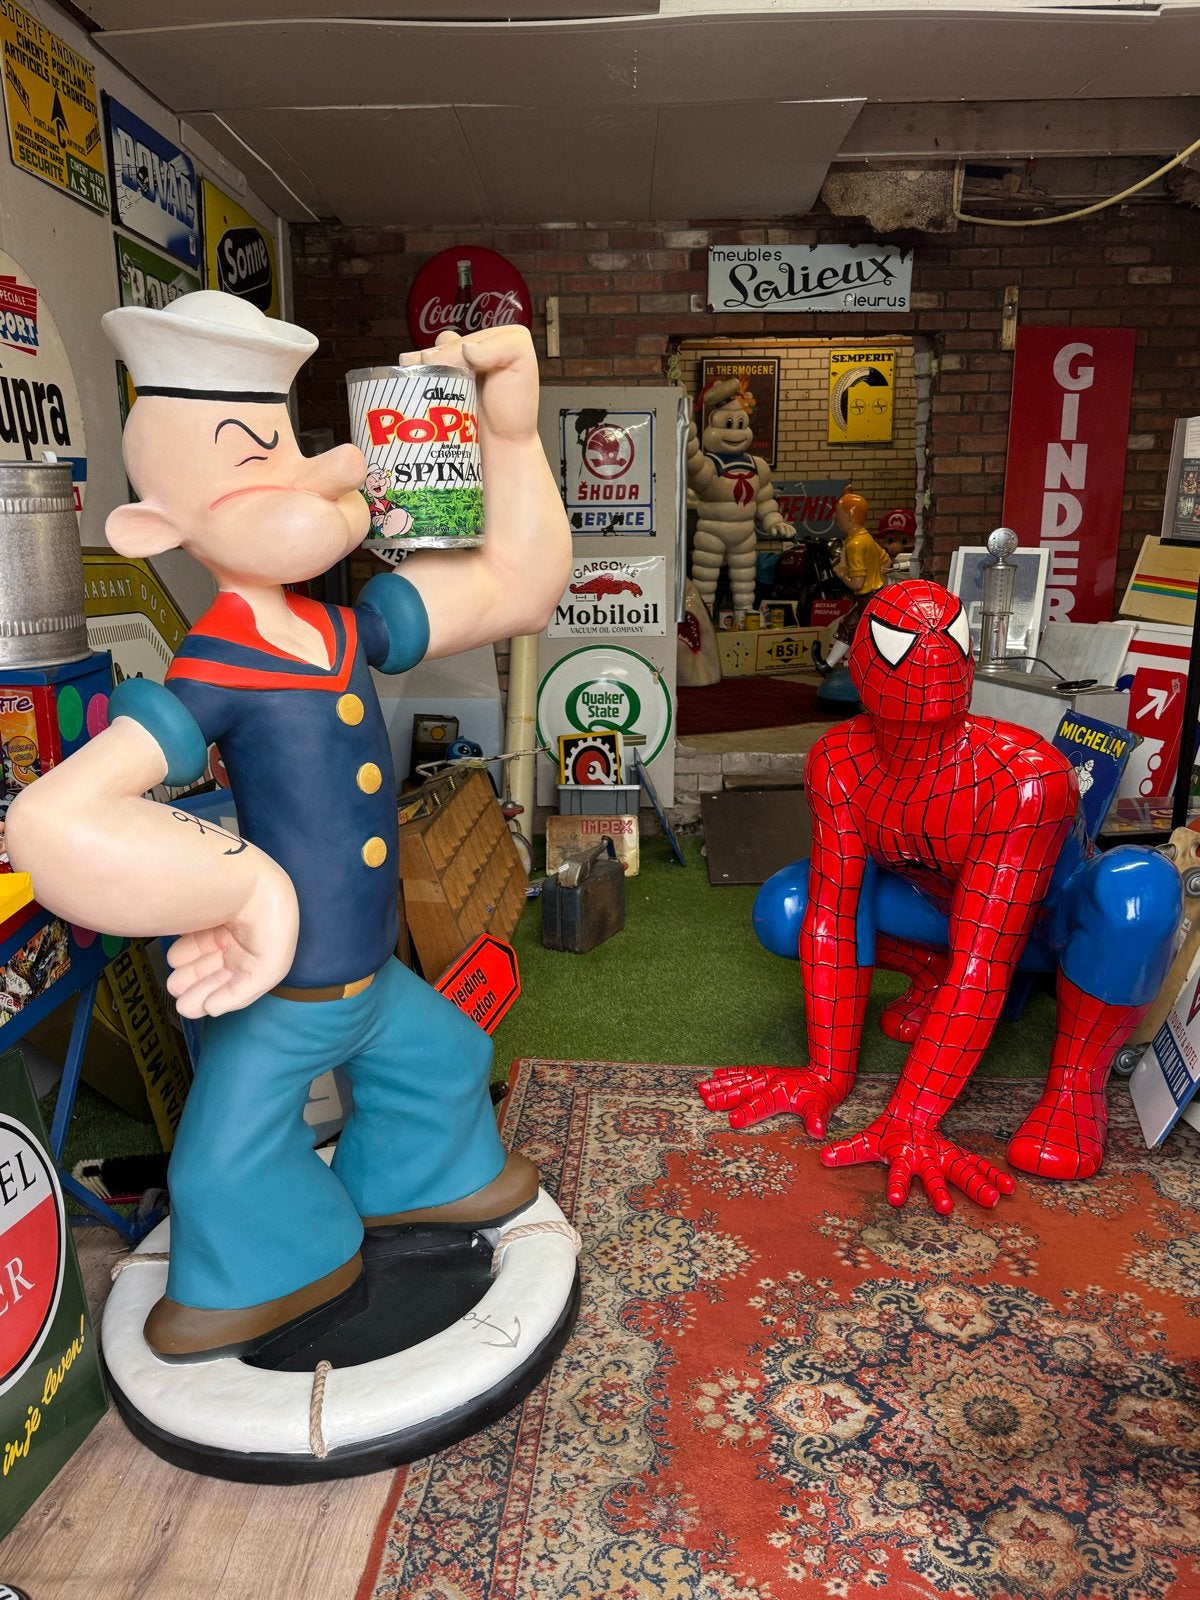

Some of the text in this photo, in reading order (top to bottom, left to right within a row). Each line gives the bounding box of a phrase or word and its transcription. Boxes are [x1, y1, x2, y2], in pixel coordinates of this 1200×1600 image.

[5, 39, 50, 84] ARTIFICIELS
[51, 75, 61, 91] DE
[16, 31, 86, 94] CIMENTS PORTLAND
[224, 237, 268, 285] Sonne
[711, 248, 783, 263] meubles
[843, 292, 907, 308] fleurus
[418, 289, 522, 335] Coca-Cola
[831, 353, 894, 363] SEMPERIT
[706, 366, 714, 376] LE
[430, 450, 472, 459] CHOPPED
[578, 481, 640, 501] ŠKODA
[1040, 342, 1096, 623] GINDER
[573, 561, 639, 579] GARGOYLE
[555, 603, 660, 626] Mobiloil
[599, 626, 611, 634] OIL
[612, 626, 645, 634] COMPANY
[581, 691, 625, 707] Quaker
[587, 704, 620, 718] State
[1059, 720, 1127, 758] MICHELIN
[581, 819, 633, 835] IMPEX
[451, 967, 488, 1008] leiding
[1155, 1027, 1190, 1101] INFORMATION
[22, 1405, 42, 1458] je
[41, 1313, 85, 1405] leven!
